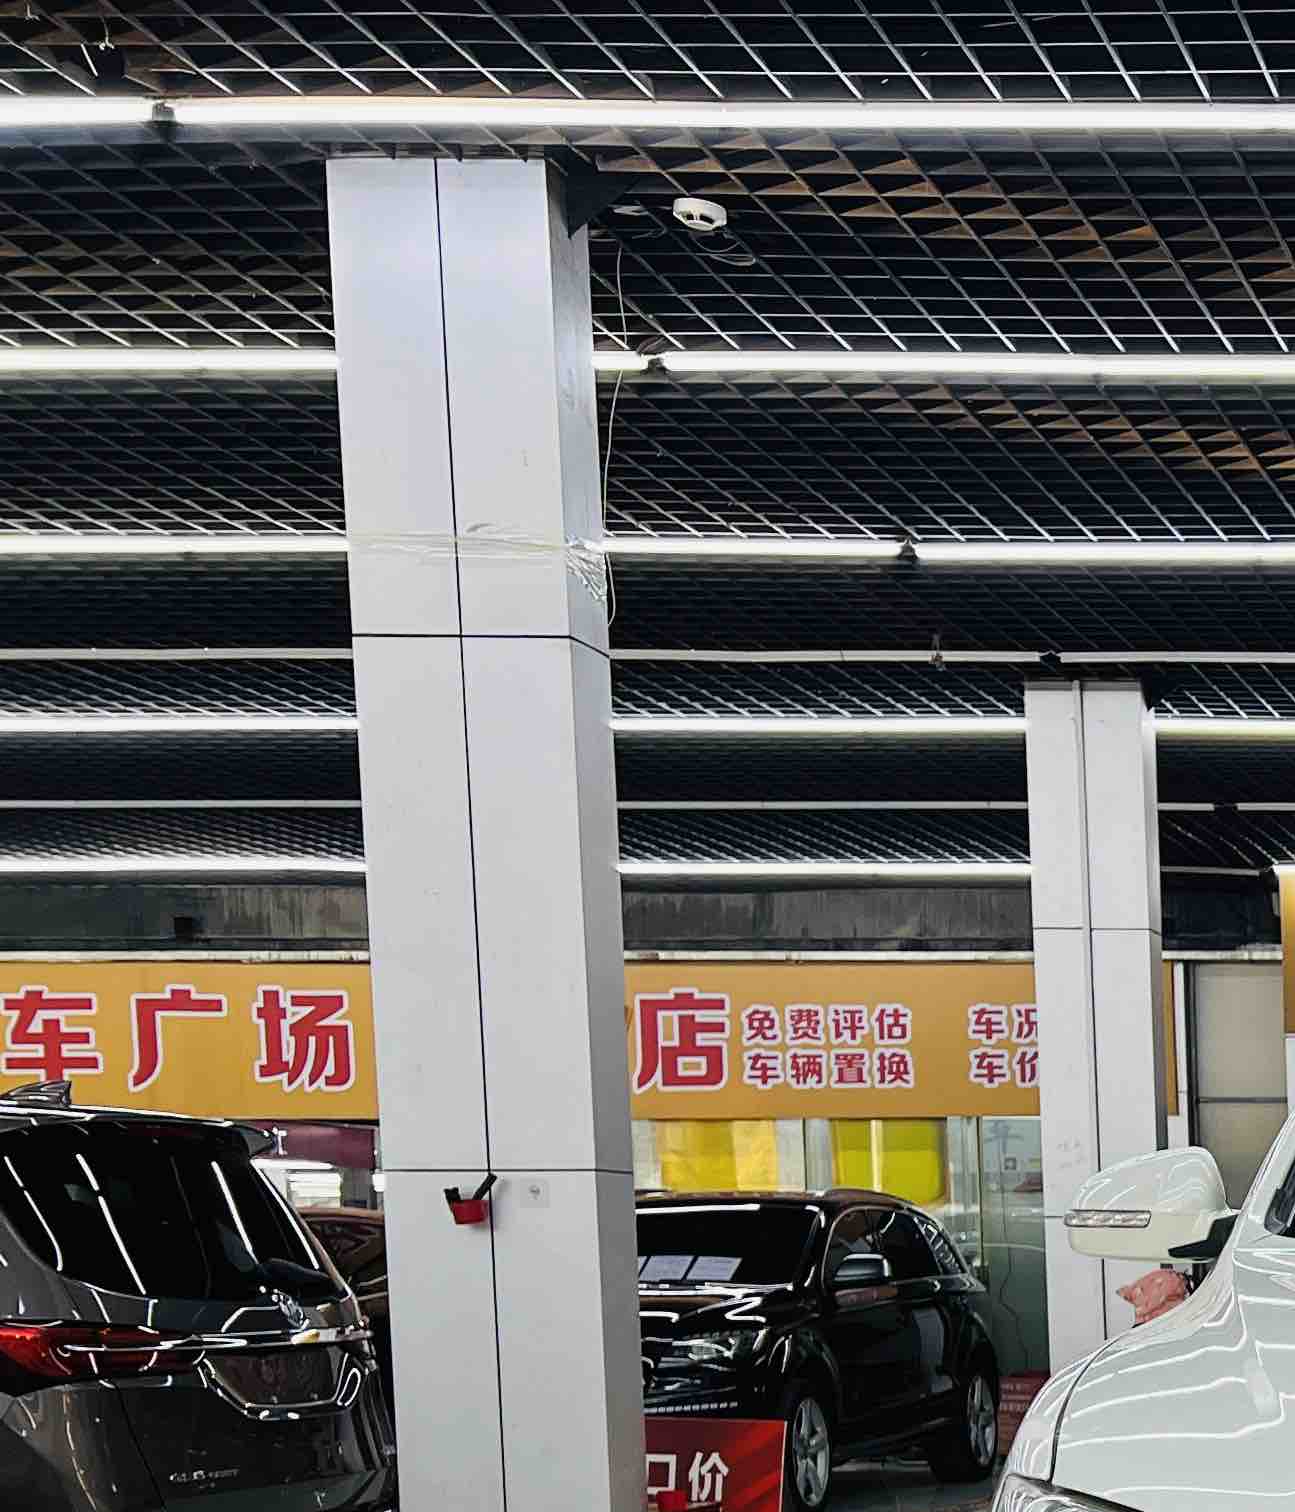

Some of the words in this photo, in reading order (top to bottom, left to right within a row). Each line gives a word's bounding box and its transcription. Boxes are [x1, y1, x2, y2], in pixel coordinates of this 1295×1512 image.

[631, 987, 731, 1093] 店
[741, 1004, 912, 1045] 免费评估
[742, 1049, 914, 1089] 车辆置换
